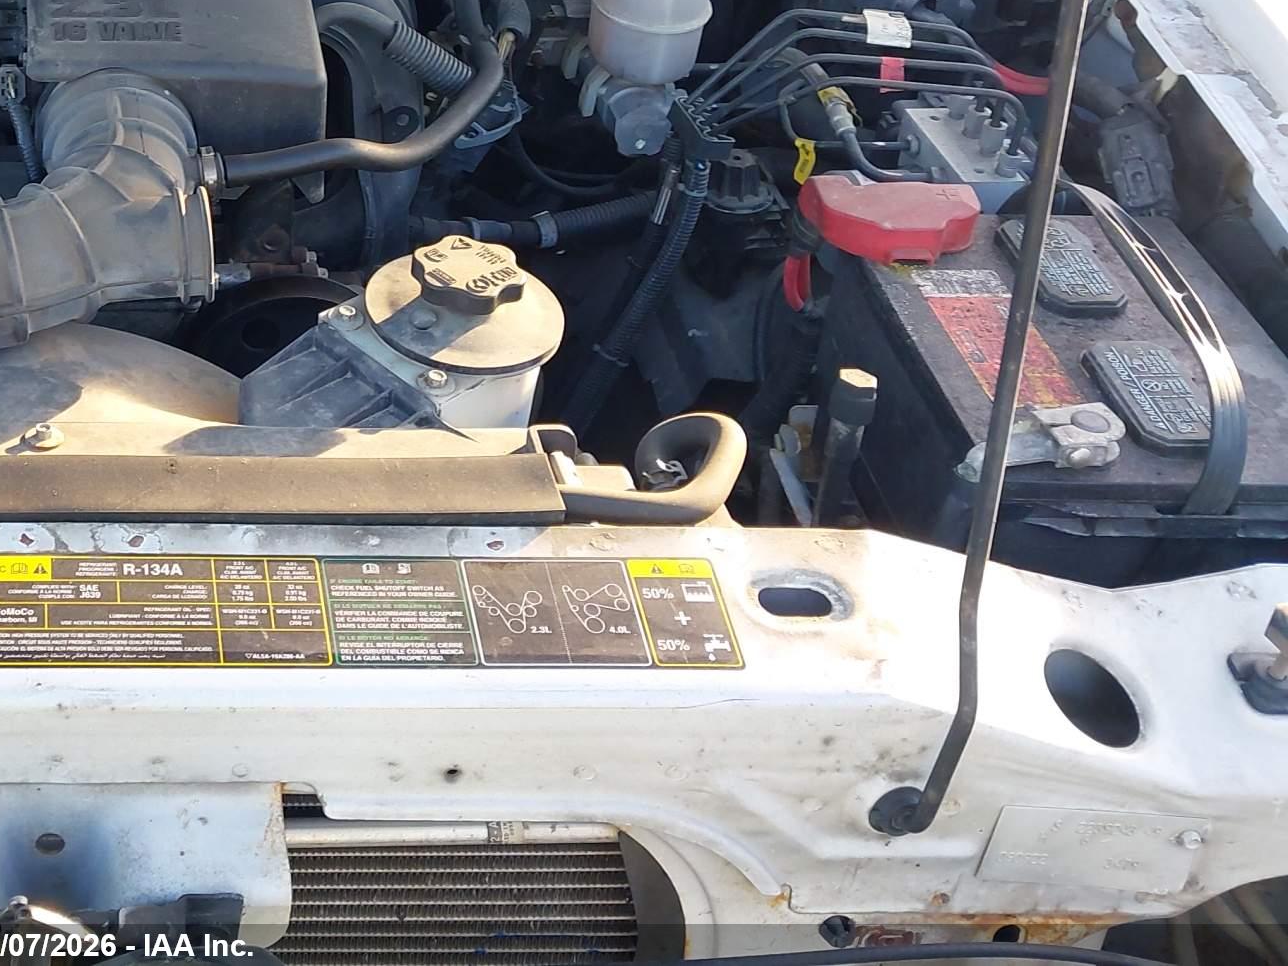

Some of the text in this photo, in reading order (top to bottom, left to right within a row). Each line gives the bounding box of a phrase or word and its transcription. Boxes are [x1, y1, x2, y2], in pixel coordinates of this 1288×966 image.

[50, 21, 182, 42] 16 VALVE
[1104, 351, 1133, 381] POISON
[1129, 388, 1163, 422] DANGER
[123, 563, 184, 576] R-134A
[79, 584, 99, 592] SAE
[641, 587, 674, 600] 50%
[79, 591, 101, 599] J639
[657, 639, 690, 651] 50%
